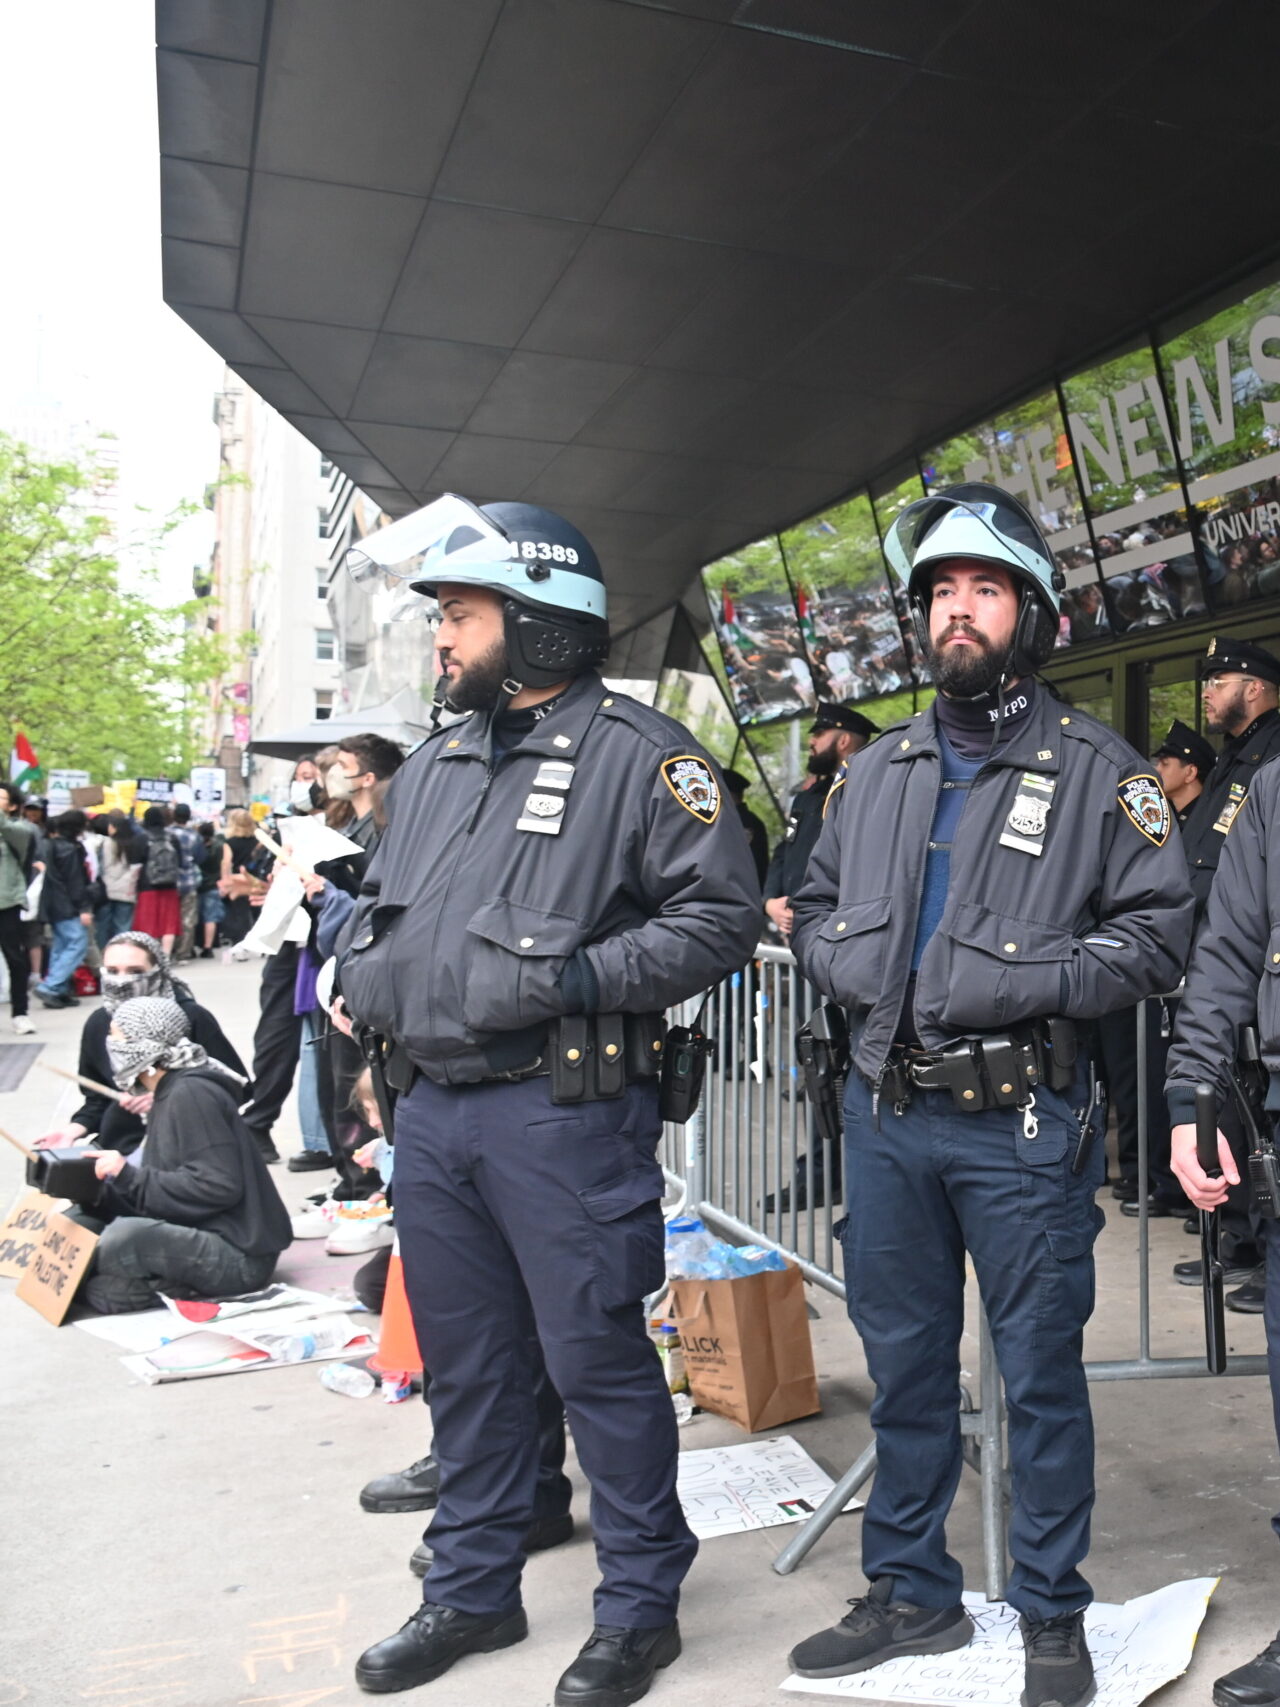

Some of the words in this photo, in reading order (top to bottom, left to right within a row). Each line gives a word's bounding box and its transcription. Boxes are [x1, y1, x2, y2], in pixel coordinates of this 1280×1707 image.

[1068, 338, 1236, 496] NEW
[510, 541, 579, 565] 18389
[1126, 779, 1151, 790] POLICE
[680, 1335, 724, 1354] LICK
[919, 1667, 1018, 1688] called
